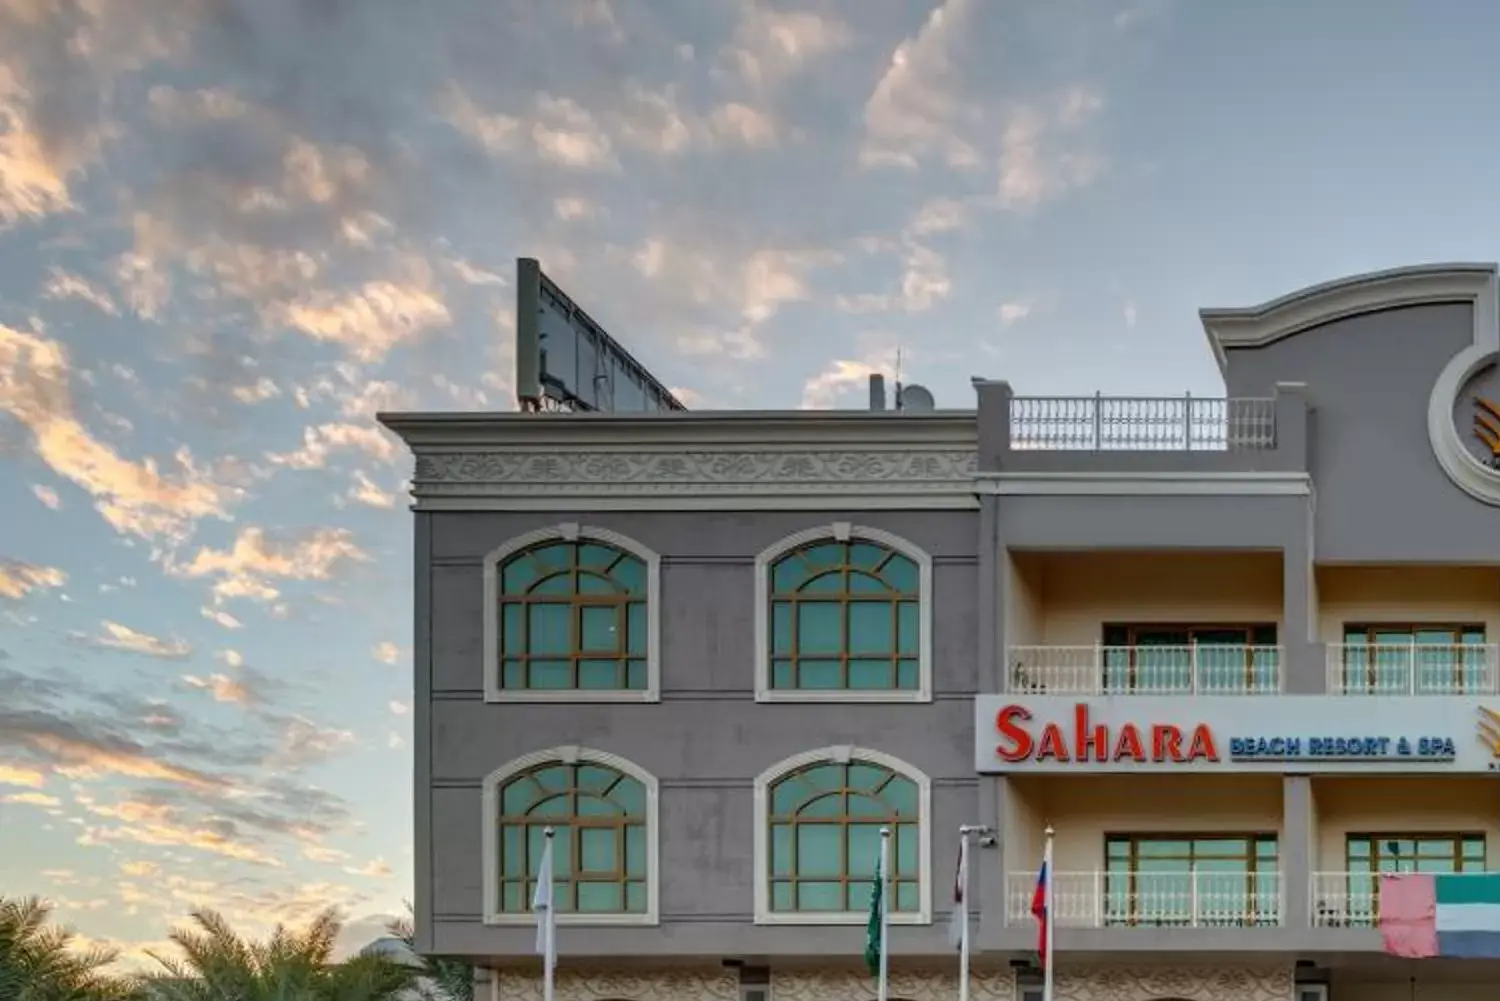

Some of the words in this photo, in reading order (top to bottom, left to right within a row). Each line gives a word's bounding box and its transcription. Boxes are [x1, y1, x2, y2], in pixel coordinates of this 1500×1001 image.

[1230, 736, 1301, 756] BEACH
[1309, 736, 1390, 756] RESORT
[1397, 736, 1411, 756] &
[1418, 736, 1455, 756] SPA
